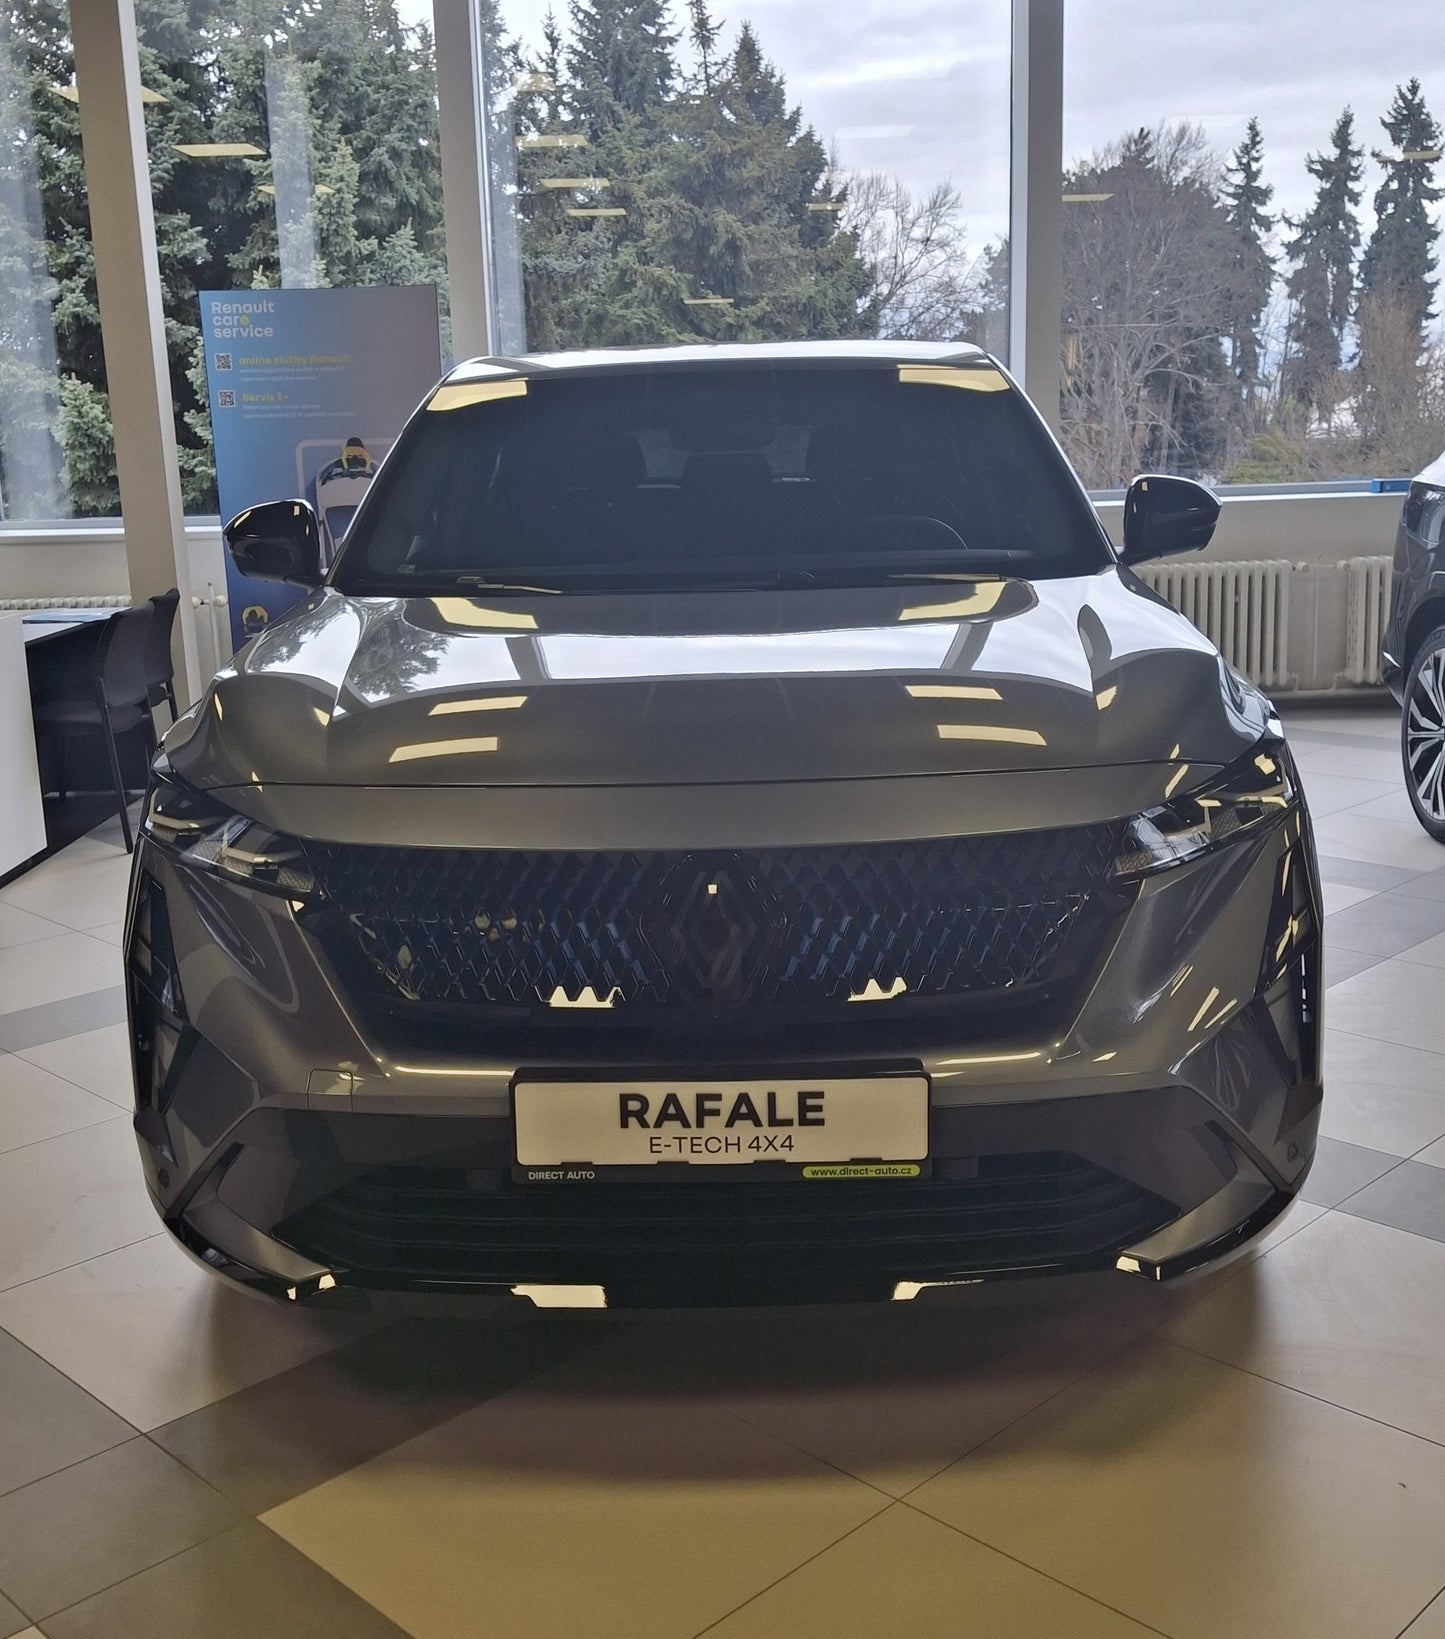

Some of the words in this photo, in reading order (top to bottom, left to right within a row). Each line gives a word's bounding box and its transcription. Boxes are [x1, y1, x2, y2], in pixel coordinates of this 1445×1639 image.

[211, 300, 275, 314] Renault
[212, 315, 249, 326] care
[213, 325, 274, 338] service
[238, 355, 272, 365] online
[619, 1091, 825, 1129] RAFALE
[649, 1136, 741, 1153] E-TECH
[747, 1134, 795, 1152] 4X4
[528, 1171, 565, 1180] DIRECT
[566, 1170, 596, 1180] AUTO
[810, 1164, 912, 1177] www.direct-auto.cz
